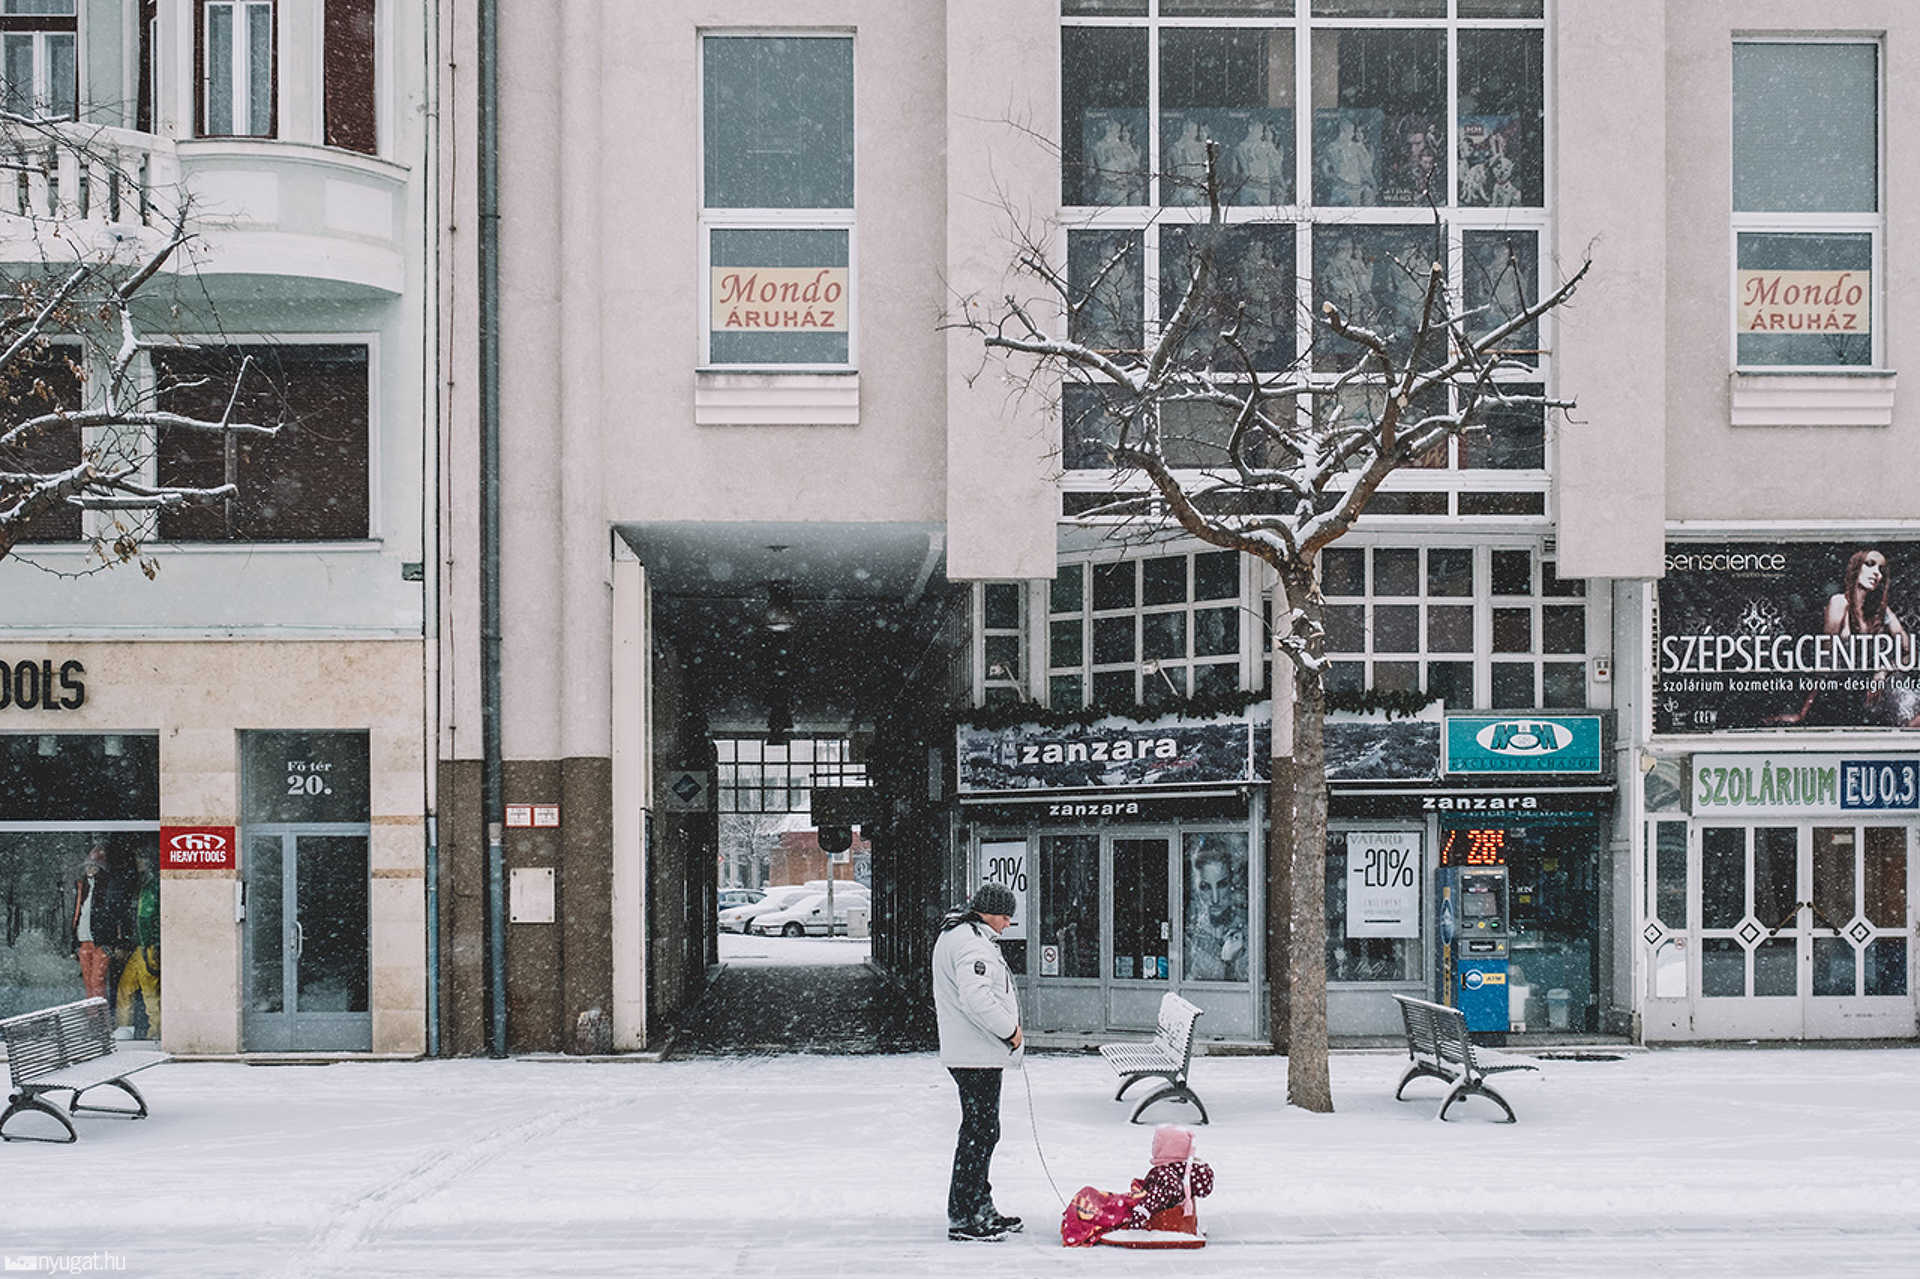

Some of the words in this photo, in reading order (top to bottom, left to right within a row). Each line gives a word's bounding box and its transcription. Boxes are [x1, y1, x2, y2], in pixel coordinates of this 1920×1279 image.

[719, 269, 842, 305] Mondo
[1743, 273, 1863, 306] Mondo
[724, 305, 836, 328] ÁRUHÁZ
[1750, 308, 1858, 331] ÁRUHÁZ
[1664, 549, 1786, 571] senscience
[1661, 624, 1920, 673] SZÉPSÉGCENTRU
[1662, 678, 1724, 692] szolárium
[1729, 678, 1794, 692] kozmetika
[1022, 737, 1177, 765] zanzara
[288, 774, 332, 796] 20.
[1698, 759, 1838, 806] SZOLÁRIUM
[1049, 802, 1140, 817] zanzara
[1422, 796, 1538, 810] zanzara
[170, 850, 199, 863] HEAVY
[199, 850, 227, 863] TOOLS
[1353, 848, 1414, 888] -20%
[982, 856, 1028, 892] -20%
